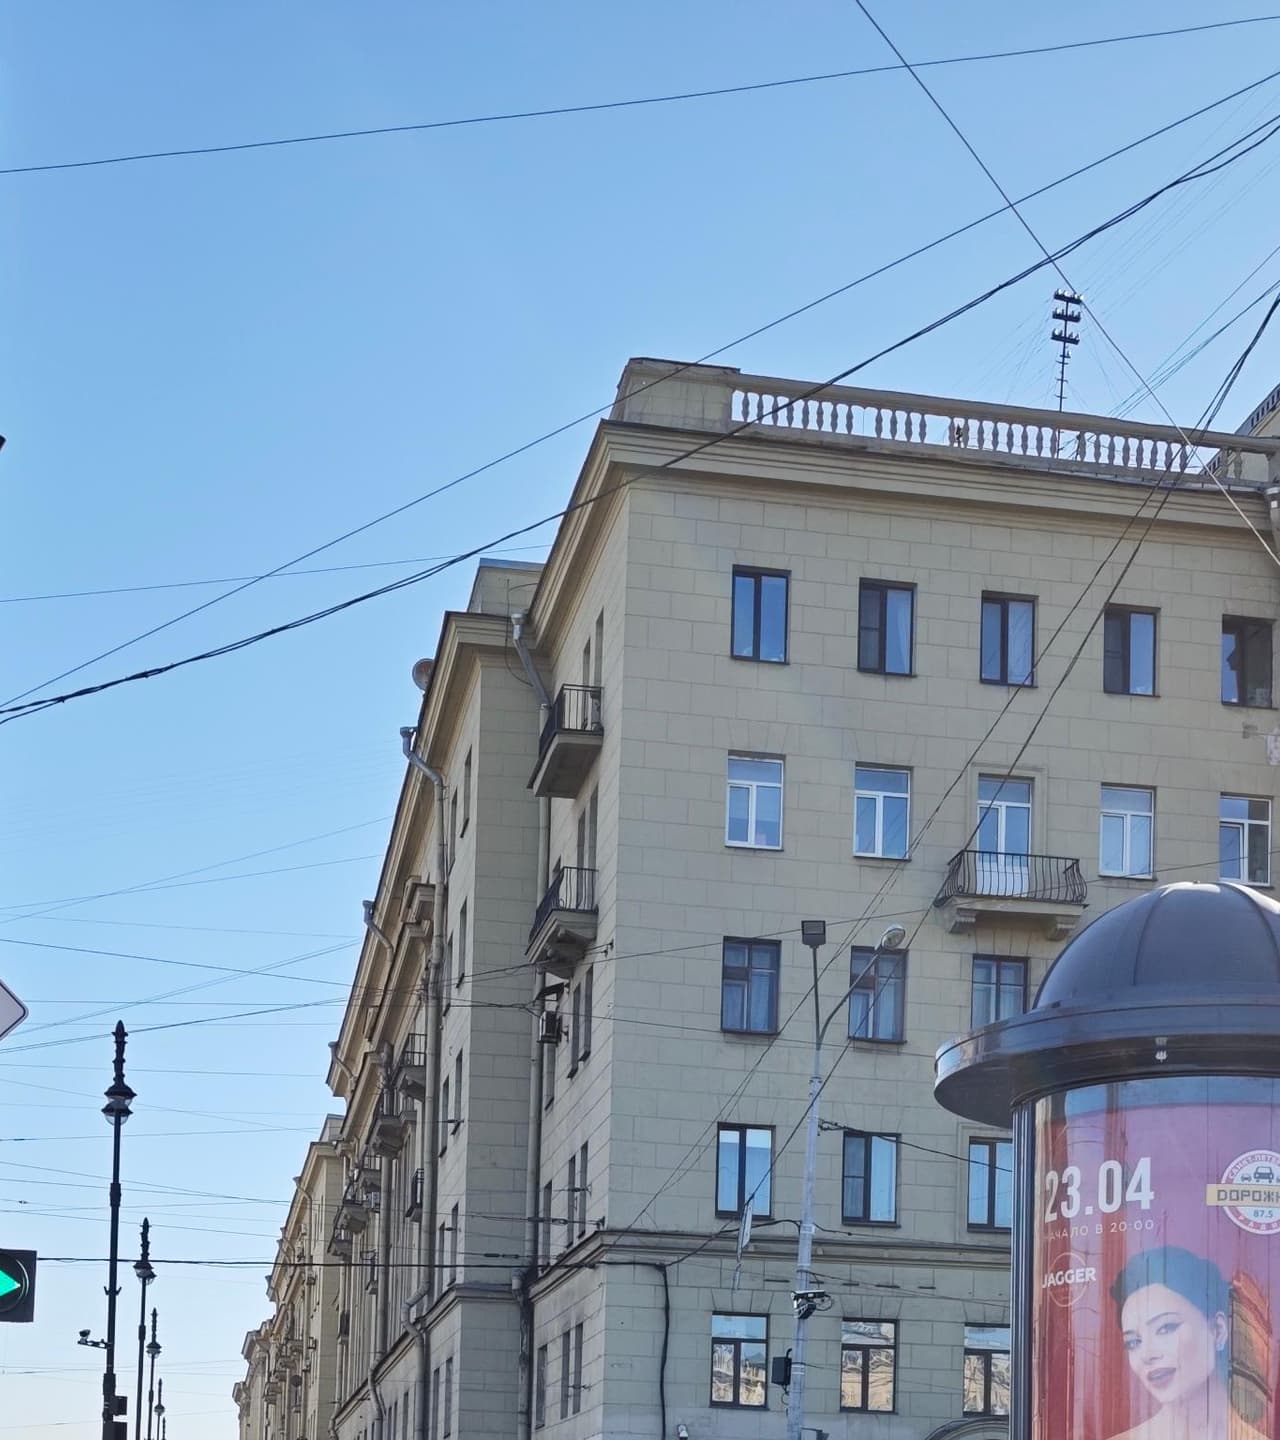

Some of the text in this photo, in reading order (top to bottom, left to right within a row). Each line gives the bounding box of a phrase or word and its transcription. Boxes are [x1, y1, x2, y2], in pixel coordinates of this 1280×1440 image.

[1044, 1157, 1155, 1224] 23.04
[1253, 1209, 1273, 1218] 87.5
[1096, 1224, 1103, 1234] В
[1041, 1266, 1097, 1289] JAGGER
